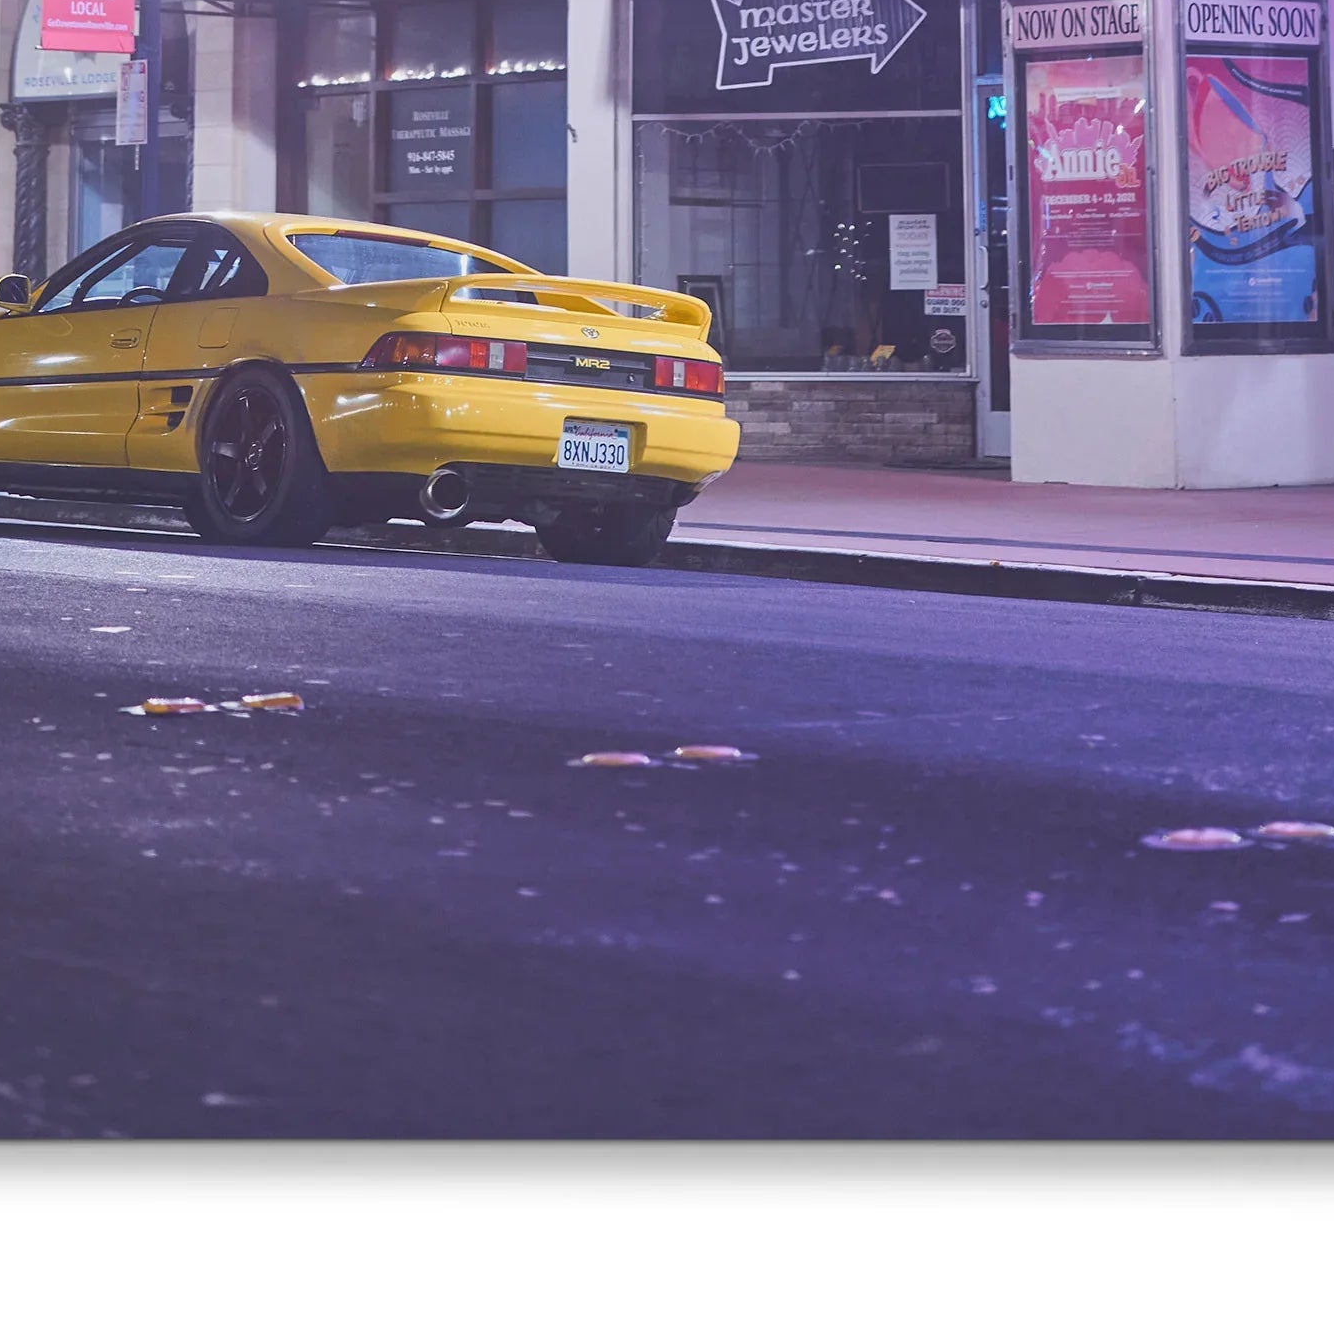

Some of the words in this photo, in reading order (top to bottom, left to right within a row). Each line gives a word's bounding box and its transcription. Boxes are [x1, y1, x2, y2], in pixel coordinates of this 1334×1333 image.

[70, 1, 107, 17] LOCAL
[1017, 9, 1057, 41] NOW
[1061, 7, 1086, 38] ON
[1090, 4, 1140, 37] STAGE
[1188, 2, 1264, 36] OPENING
[1268, 6, 1316, 38] SOON
[82, 72, 116, 85] LODGE
[1041, 139, 1121, 182] Annie
[1204, 165, 1231, 195] BIG
[1230, 151, 1288, 178] TROUBLE
[1042, 194, 1091, 205] DECEMBER
[575, 357, 611, 370] MR2
[574, 425, 615, 440] California
[563, 439, 626, 465] 8XNJ330
